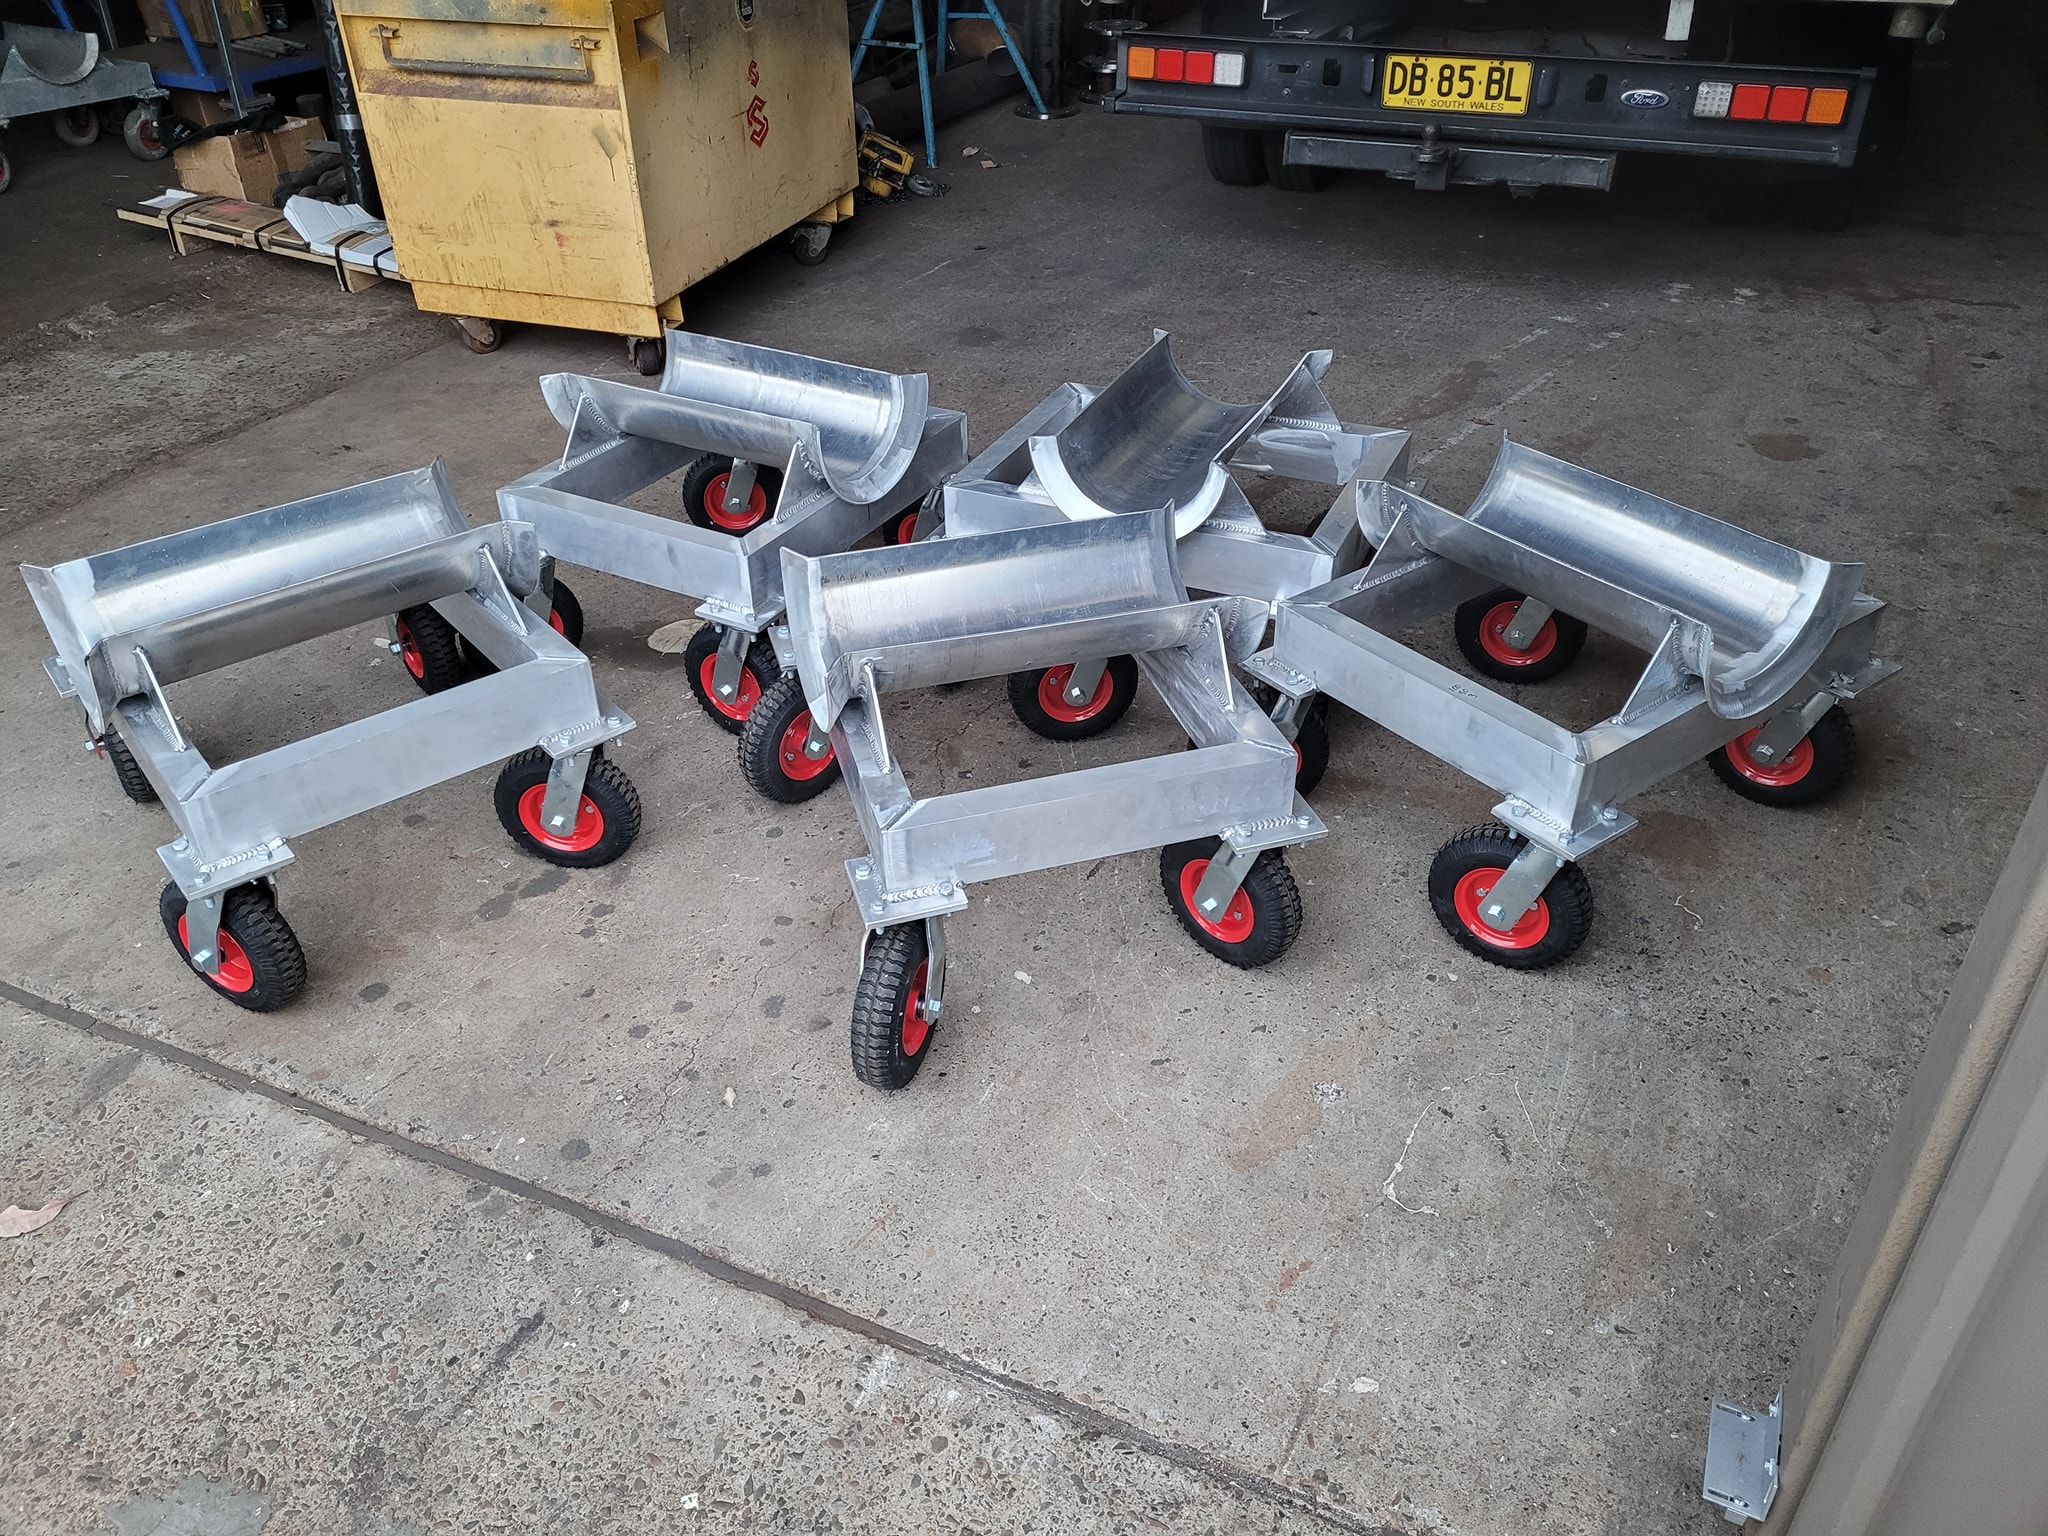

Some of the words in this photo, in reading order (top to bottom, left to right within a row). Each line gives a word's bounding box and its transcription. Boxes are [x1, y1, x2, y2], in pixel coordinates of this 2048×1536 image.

[1403, 97, 1426, 107] NEW
[1430, 99, 1465, 109] SOUTH
[1470, 101, 1504, 111] WALES
[1630, 92, 1660, 105] Ford
